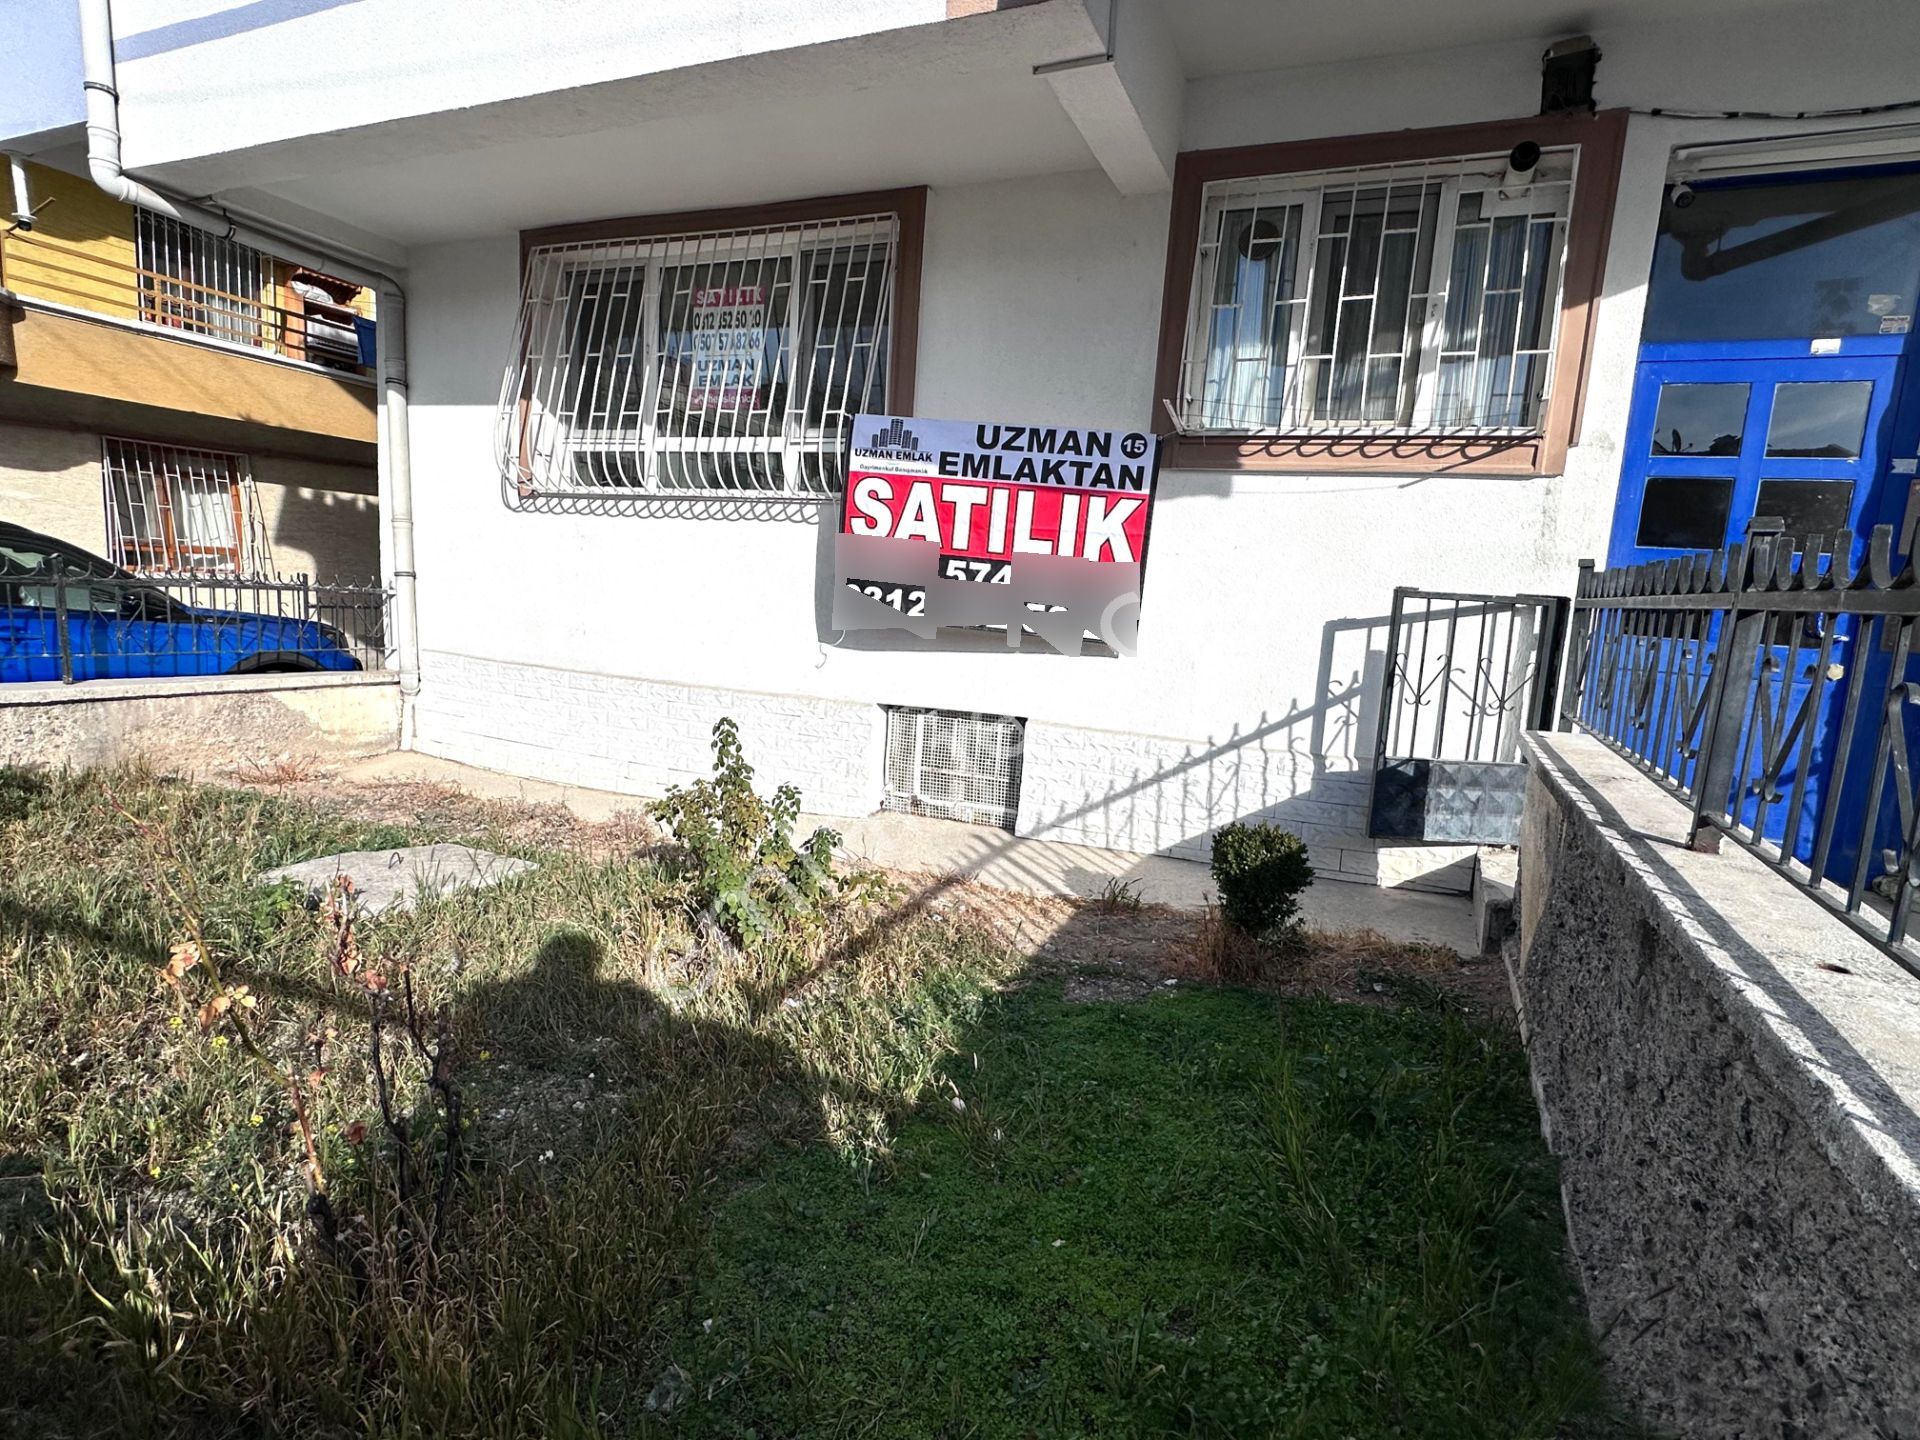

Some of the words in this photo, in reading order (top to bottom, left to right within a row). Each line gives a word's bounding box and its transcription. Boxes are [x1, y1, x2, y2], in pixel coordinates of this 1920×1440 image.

[698, 359, 754, 371] UZMAN
[854, 448, 893, 459] UZMAN
[895, 451, 933, 462] EMLAK
[975, 424, 1113, 458] UZMAN
[1122, 438, 1146, 454] 15
[938, 451, 1146, 491] EMLAKTAN
[850, 477, 1147, 562] SATILIK
[847, 583, 925, 617] 12
